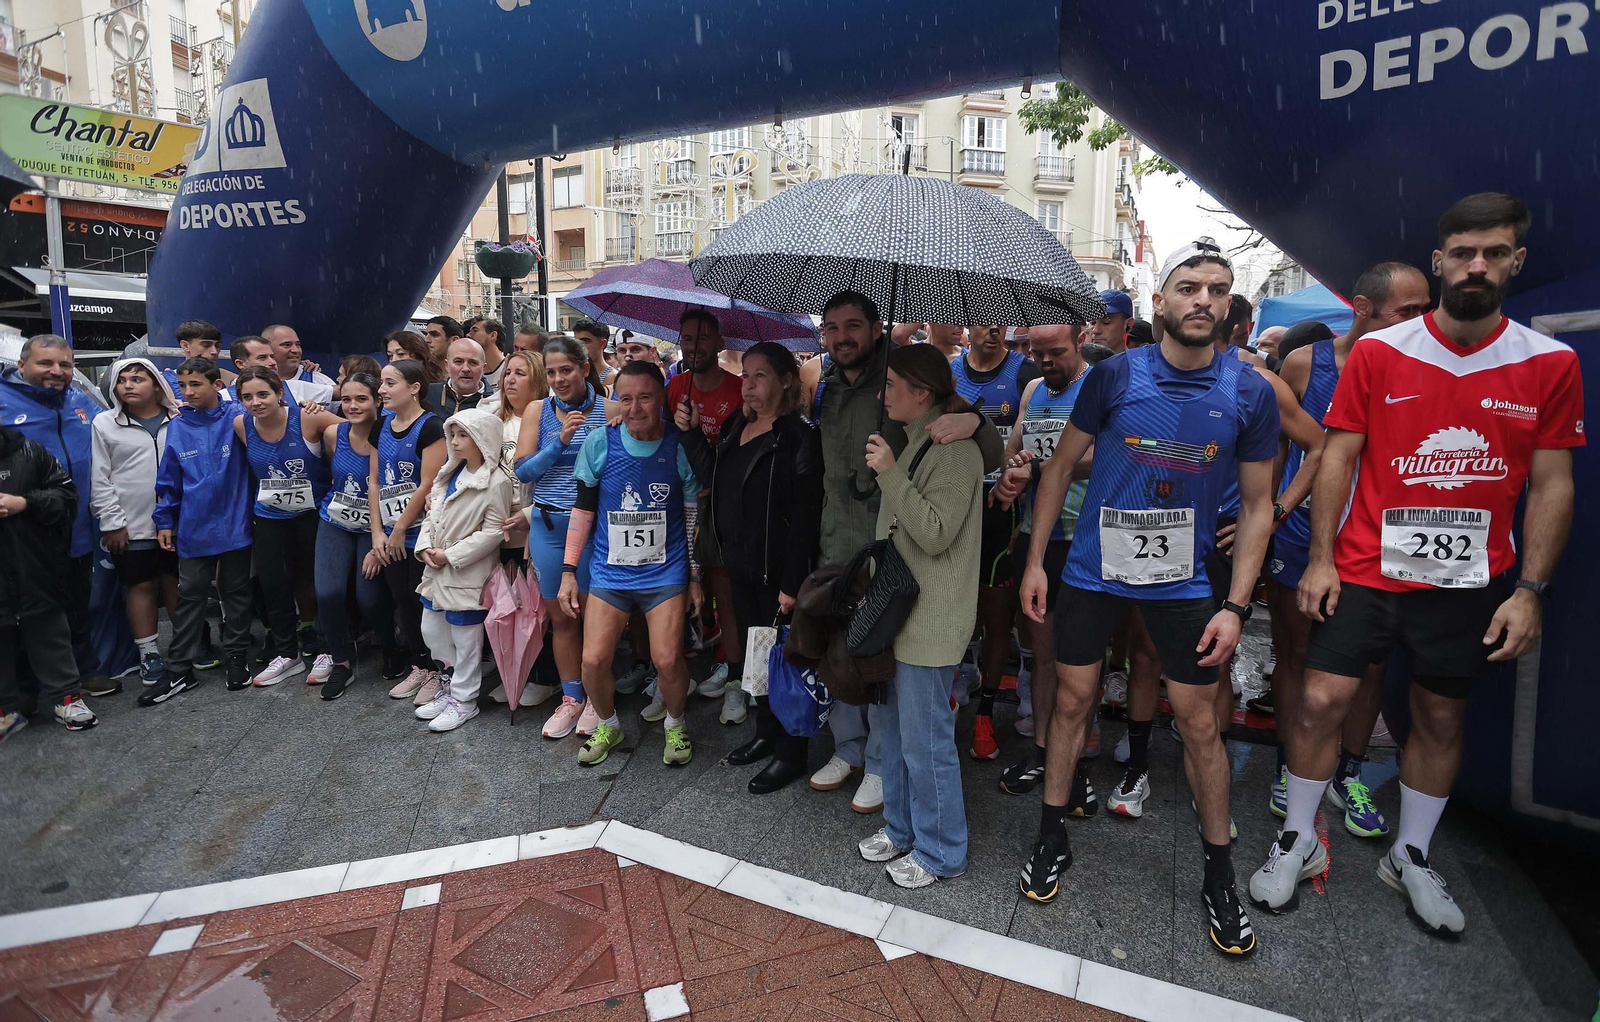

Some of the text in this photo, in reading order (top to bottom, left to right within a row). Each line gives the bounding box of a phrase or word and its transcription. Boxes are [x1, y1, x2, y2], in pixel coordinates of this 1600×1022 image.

[1320, 1, 1600, 100] DEPOR
[30, 104, 165, 152] Chantal
[44, 141, 151, 165] CENTRO ESTÉTICO
[61, 152, 136, 172] VENTA DE PRODUCTOS
[60, 164, 74, 175] DE
[77, 166, 119, 183] TETUÁN,
[123, 174, 129, 183] 5
[161, 179, 178, 190] 956
[181, 174, 265, 196] DELEGACIÓN DE
[180, 199, 306, 230] DEPORTES
[1493, 399, 1538, 414] johnson
[1432, 447, 1481, 459] Ferretería
[1391, 452, 1508, 479] Villagrán
[272, 491, 305, 505] 375
[340, 508, 371, 525] 595
[1120, 511, 1187, 526] INMACULADA
[1407, 509, 1482, 523] INMACULADA
[622, 529, 656, 547] 151
[1132, 534, 1170, 559] 23
[1409, 532, 1472, 562] 282
